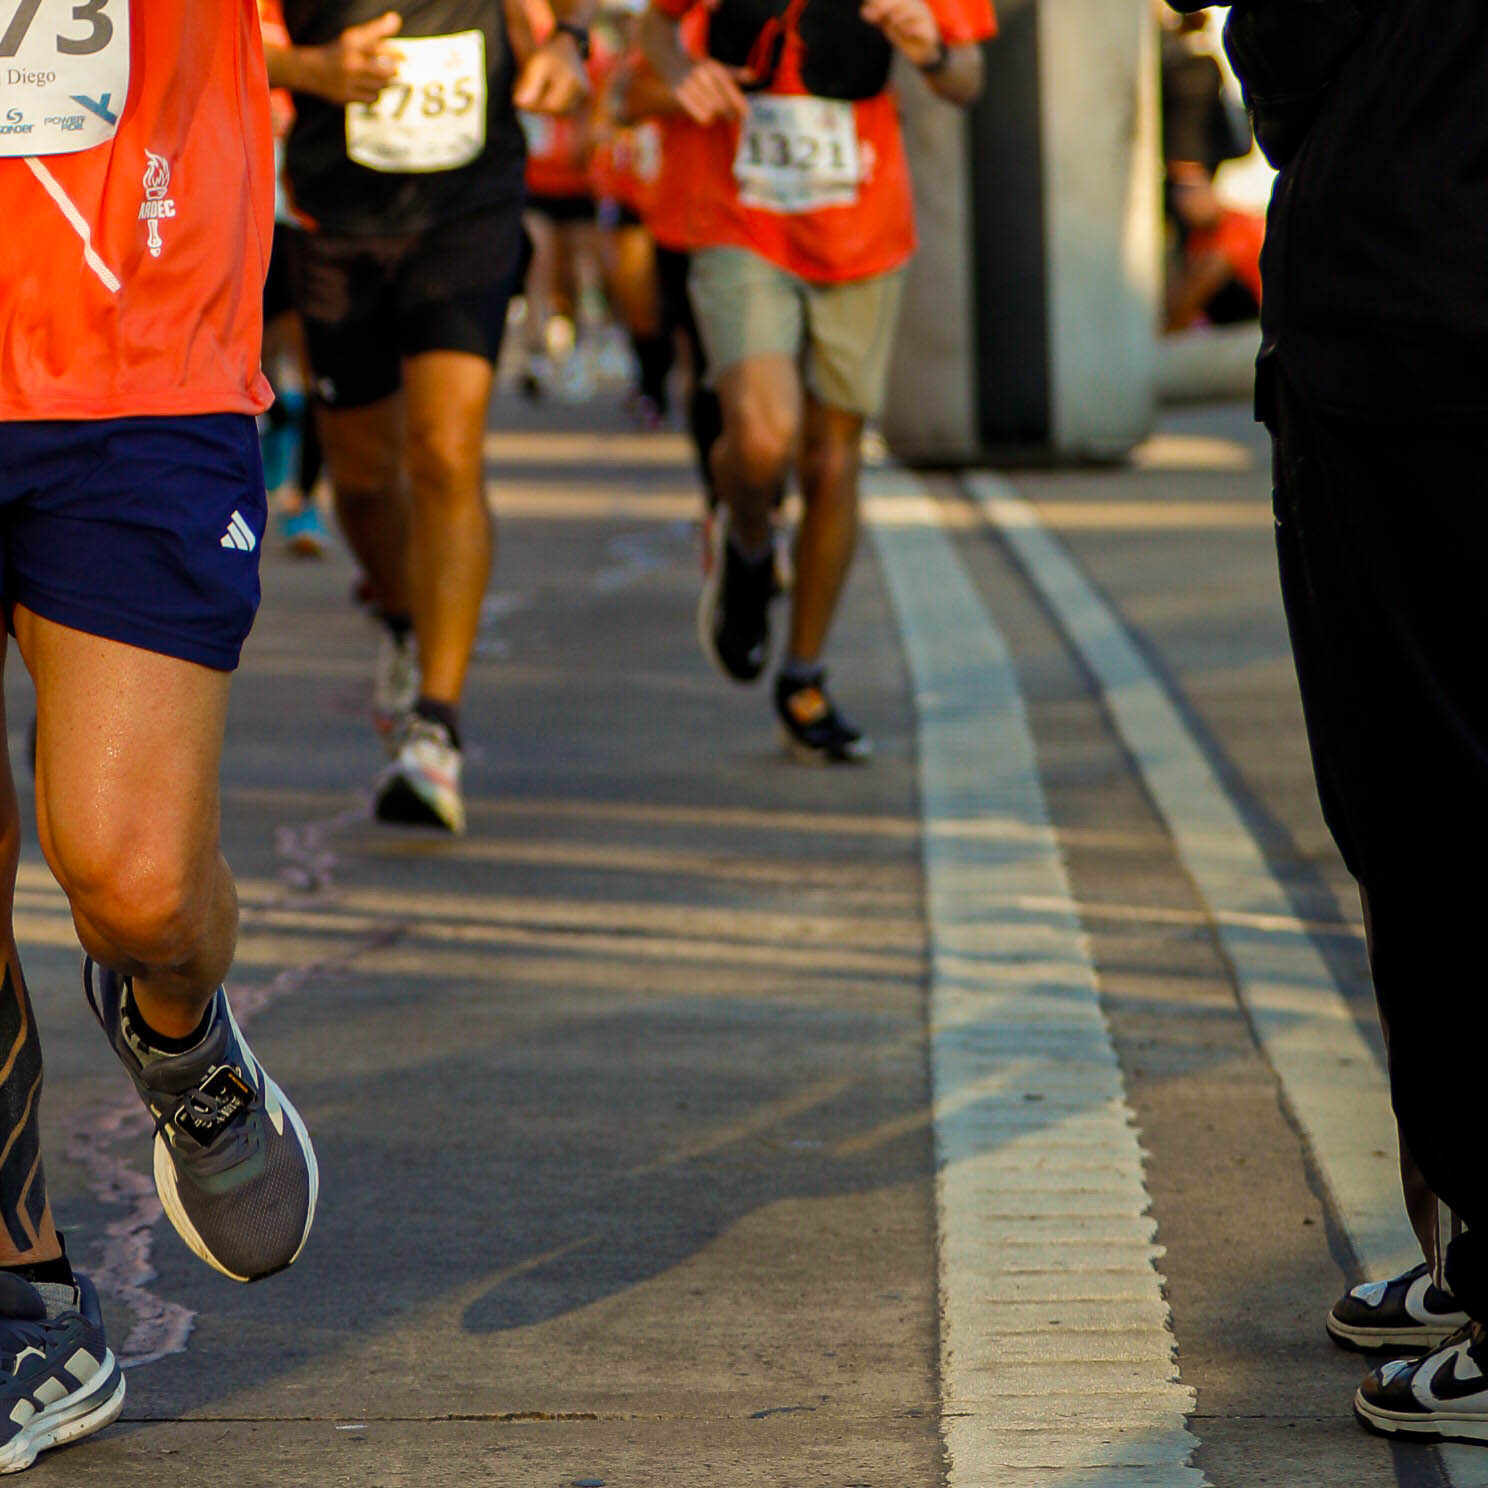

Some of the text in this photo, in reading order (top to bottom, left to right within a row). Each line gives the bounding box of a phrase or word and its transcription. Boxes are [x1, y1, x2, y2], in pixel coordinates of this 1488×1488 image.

[8, 68, 56, 87] Diego
[364, 77, 473, 120] 785
[138, 199, 176, 220] ARDEC
